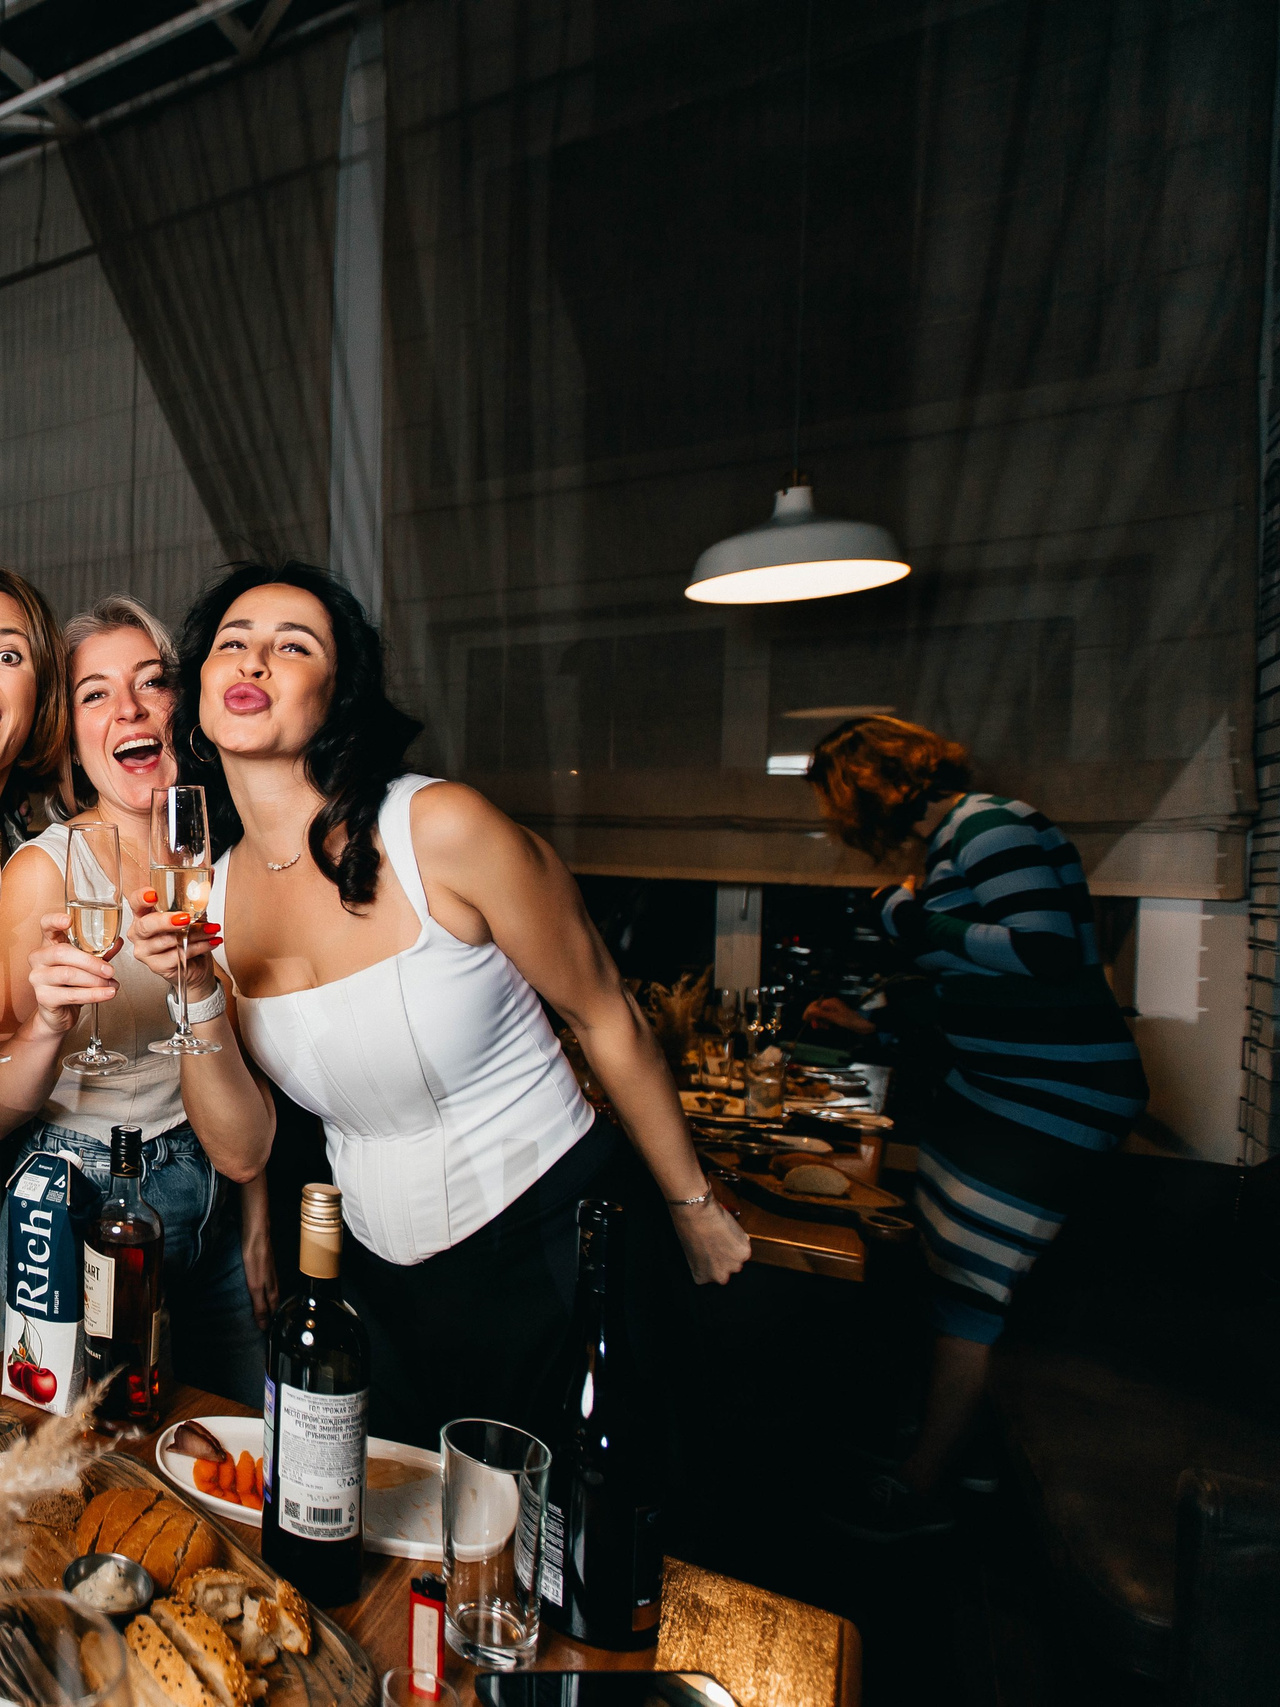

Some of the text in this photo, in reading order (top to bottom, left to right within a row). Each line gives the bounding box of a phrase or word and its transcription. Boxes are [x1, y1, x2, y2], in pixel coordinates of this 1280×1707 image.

[16, 1209, 53, 1316] Rich
[284, 1407, 300, 1419] МЕСТО
[301, 1413, 350, 1426] ПРОИСХОЖДЕНИЯ
[321, 1405, 346, 1415] УРОЖАЯ
